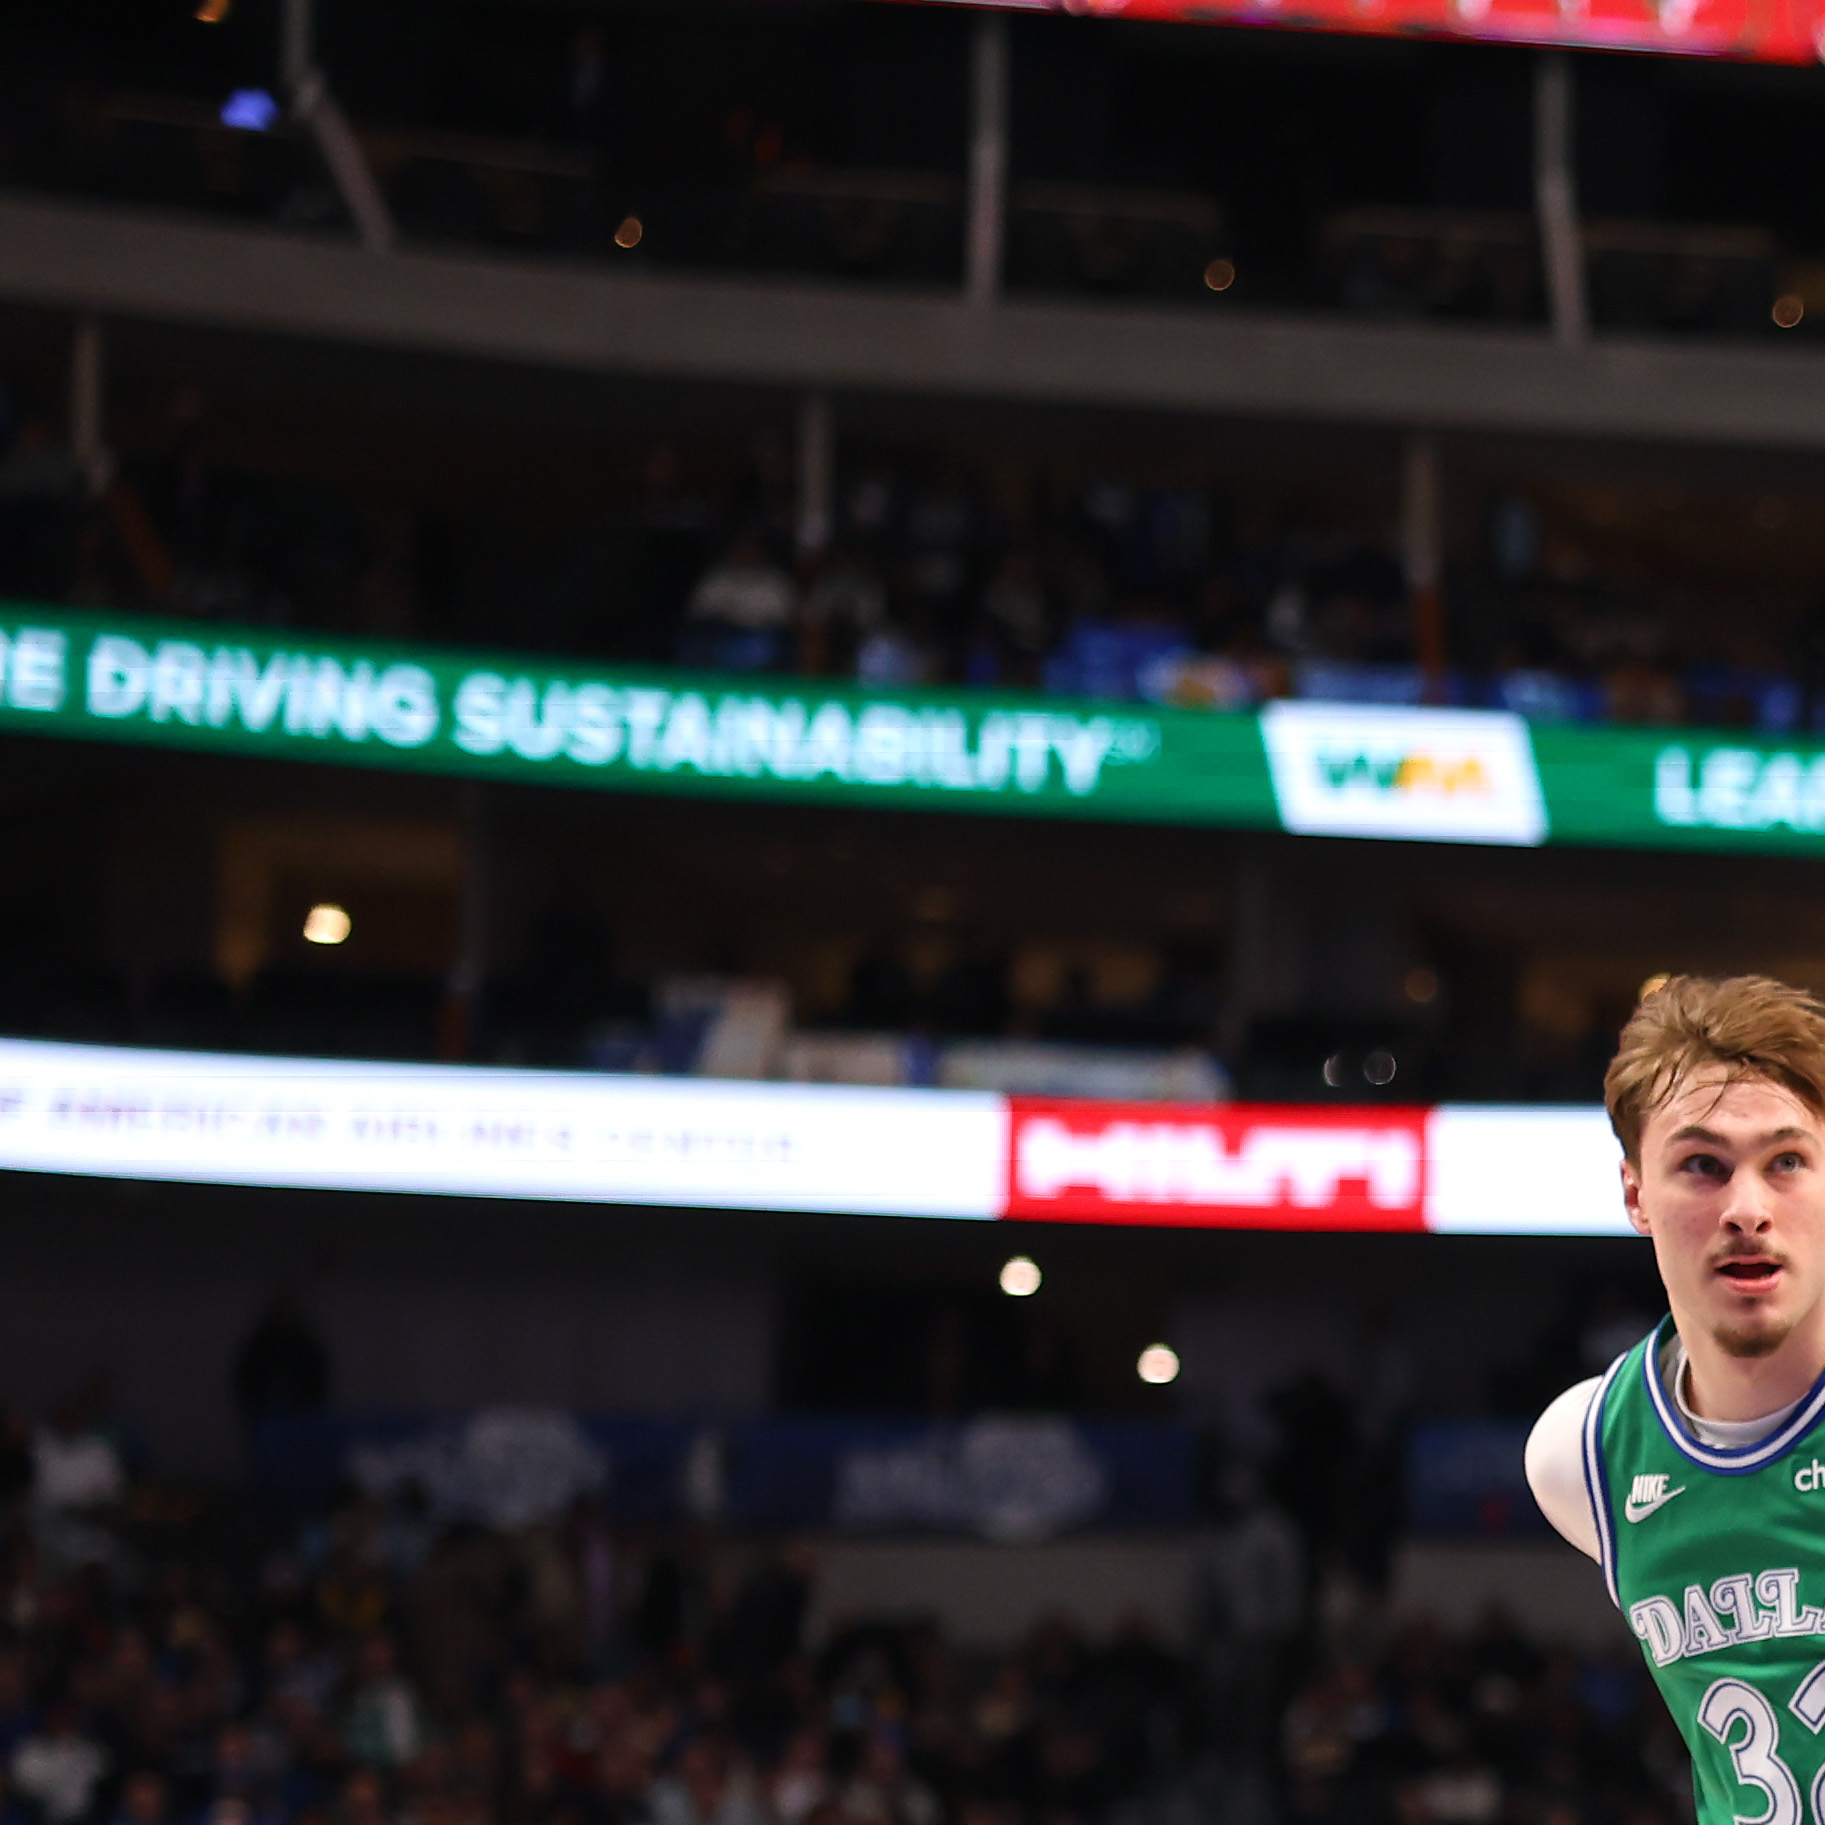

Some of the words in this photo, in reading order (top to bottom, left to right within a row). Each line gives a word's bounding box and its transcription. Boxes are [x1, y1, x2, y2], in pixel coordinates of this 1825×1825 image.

[88, 634, 438, 746] DRIVING
[454, 674, 1112, 792] SUSTAINABILITY
[1631, 1474, 1669, 1504] NIKE
